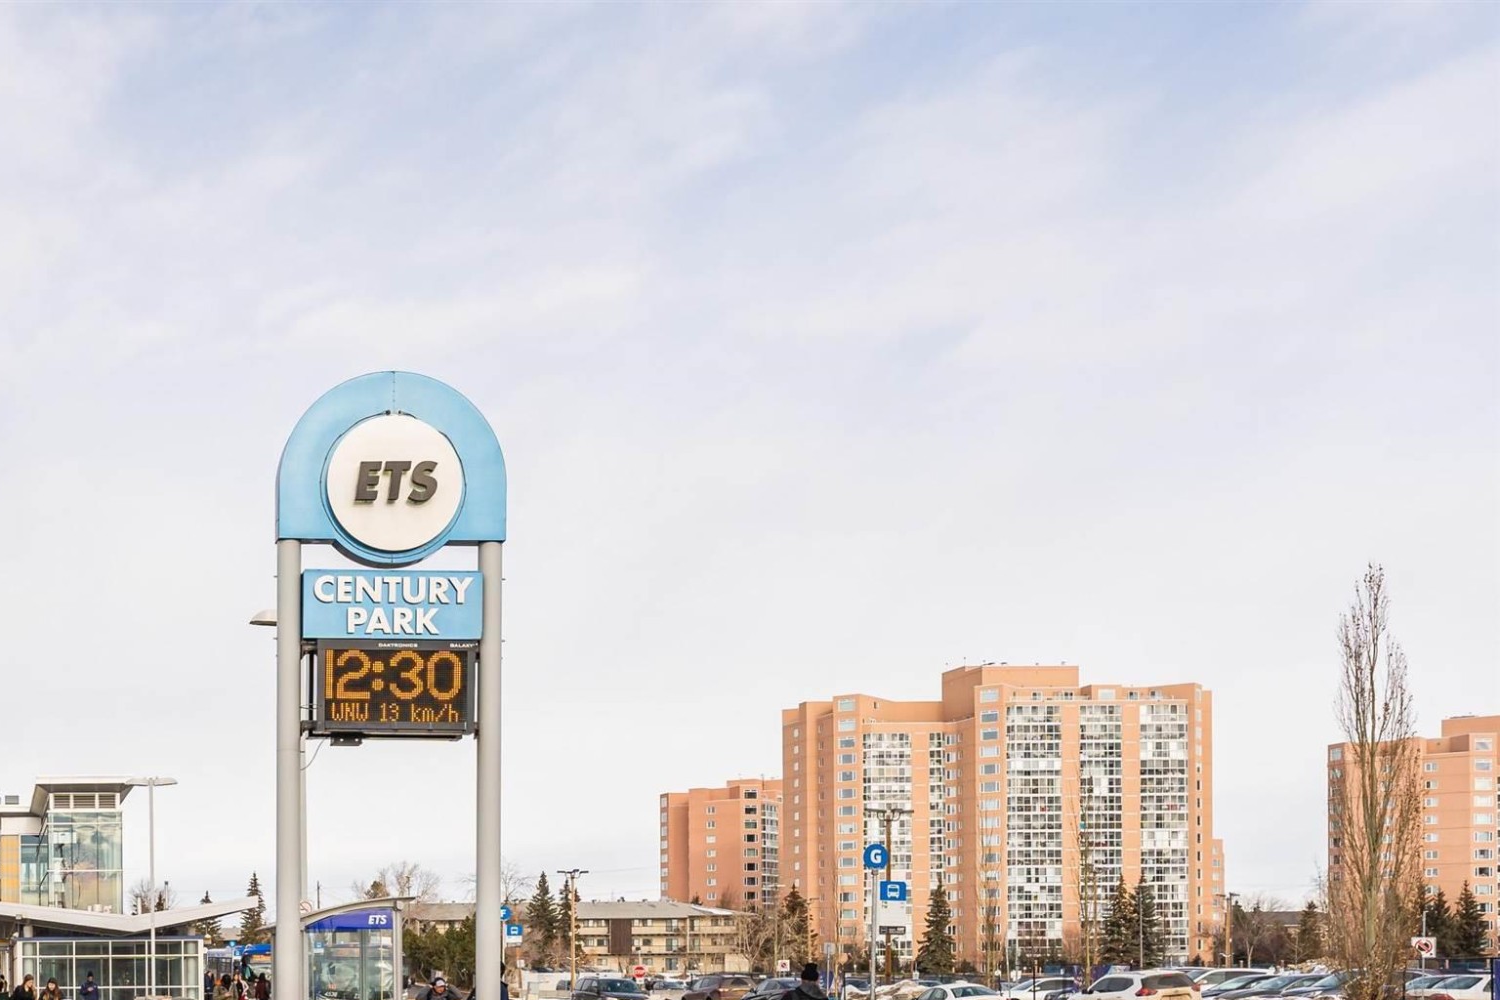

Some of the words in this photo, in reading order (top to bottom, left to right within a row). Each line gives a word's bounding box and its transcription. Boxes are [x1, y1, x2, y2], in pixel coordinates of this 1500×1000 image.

[354, 460, 438, 503] ETS
[313, 574, 475, 605] CENTURY
[346, 607, 440, 635] PARK
[325, 649, 462, 700] 12:30
[331, 702, 369, 722] WNW
[380, 703, 399, 722] 13
[411, 703, 459, 723] km/h
[870, 849, 882, 864] G
[368, 914, 388, 925] ETS
